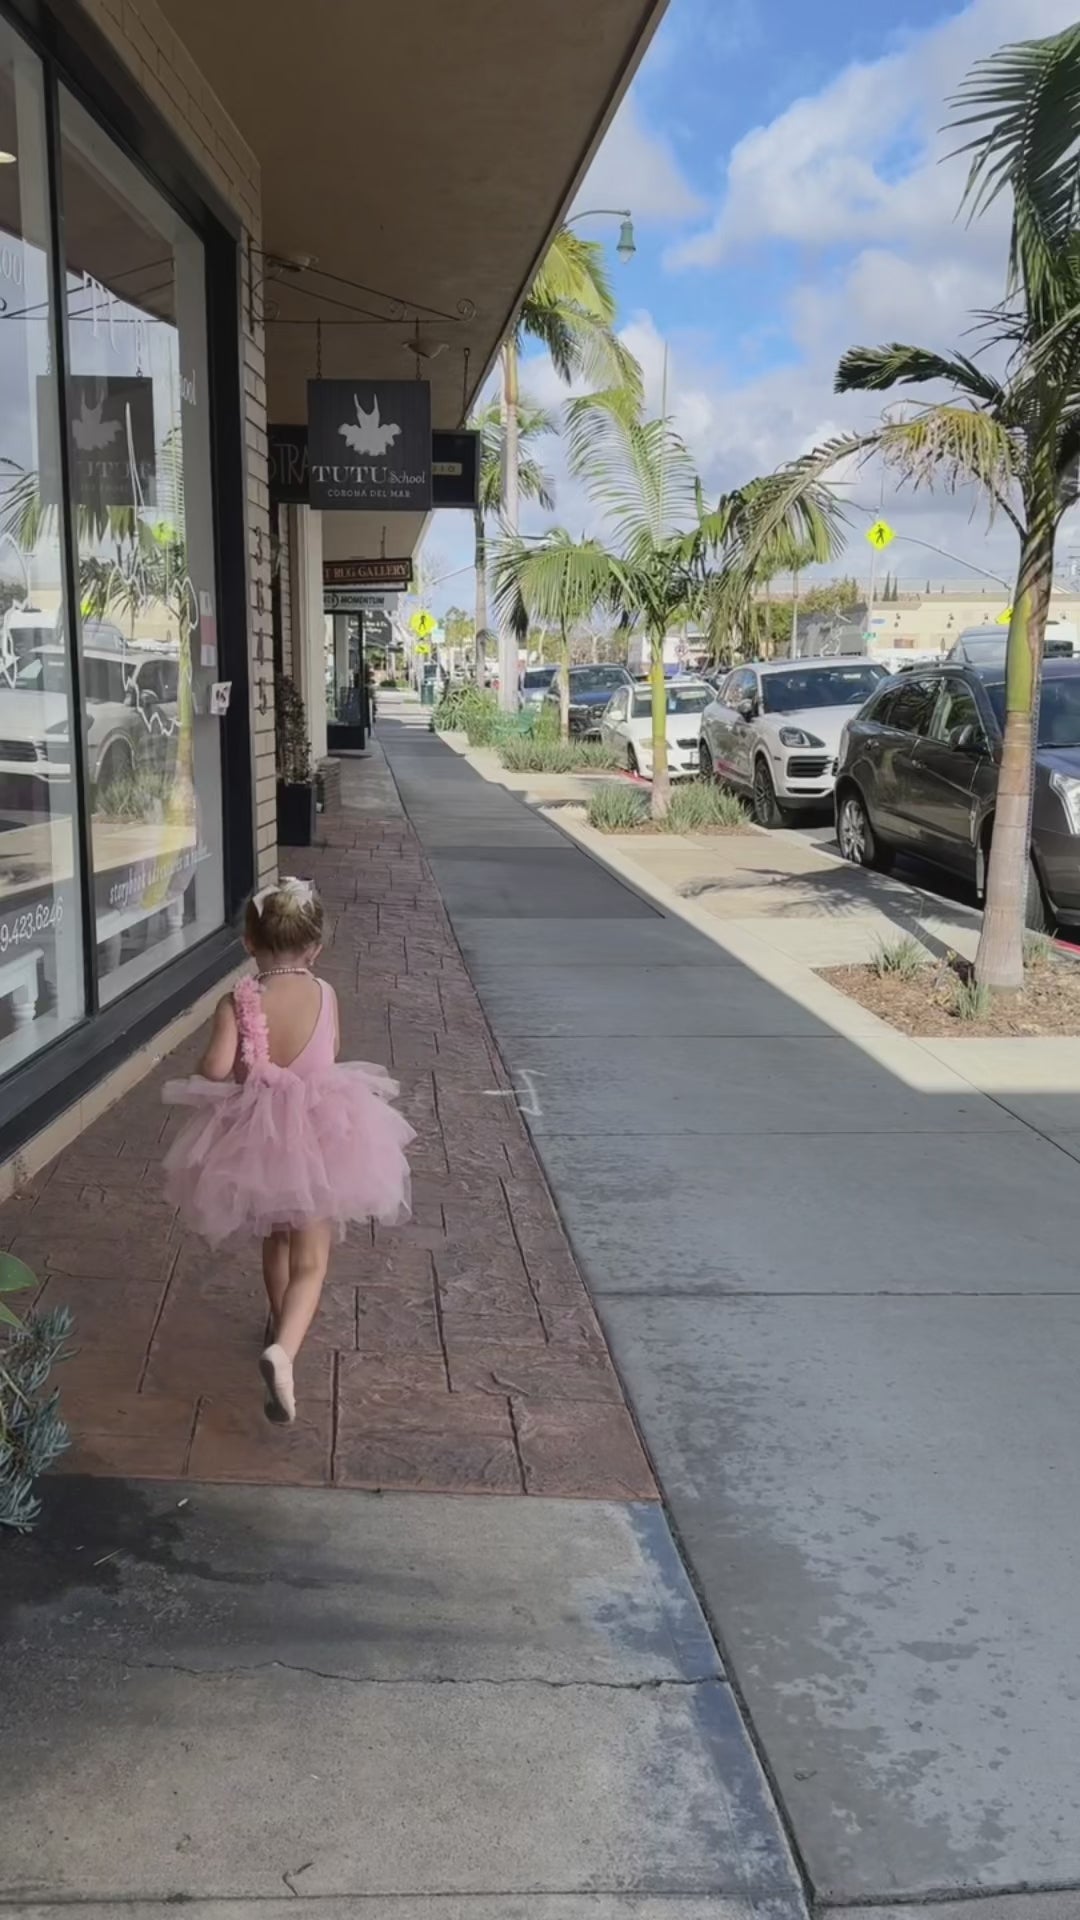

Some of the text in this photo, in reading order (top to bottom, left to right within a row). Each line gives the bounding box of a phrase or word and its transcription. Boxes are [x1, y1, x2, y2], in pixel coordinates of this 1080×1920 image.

[311, 465, 426, 484] TUTU School
[327, 489, 411, 499] CORONA DEL MAR
[333, 567, 357, 579] RUG
[358, 564, 406, 578] GALLERY
